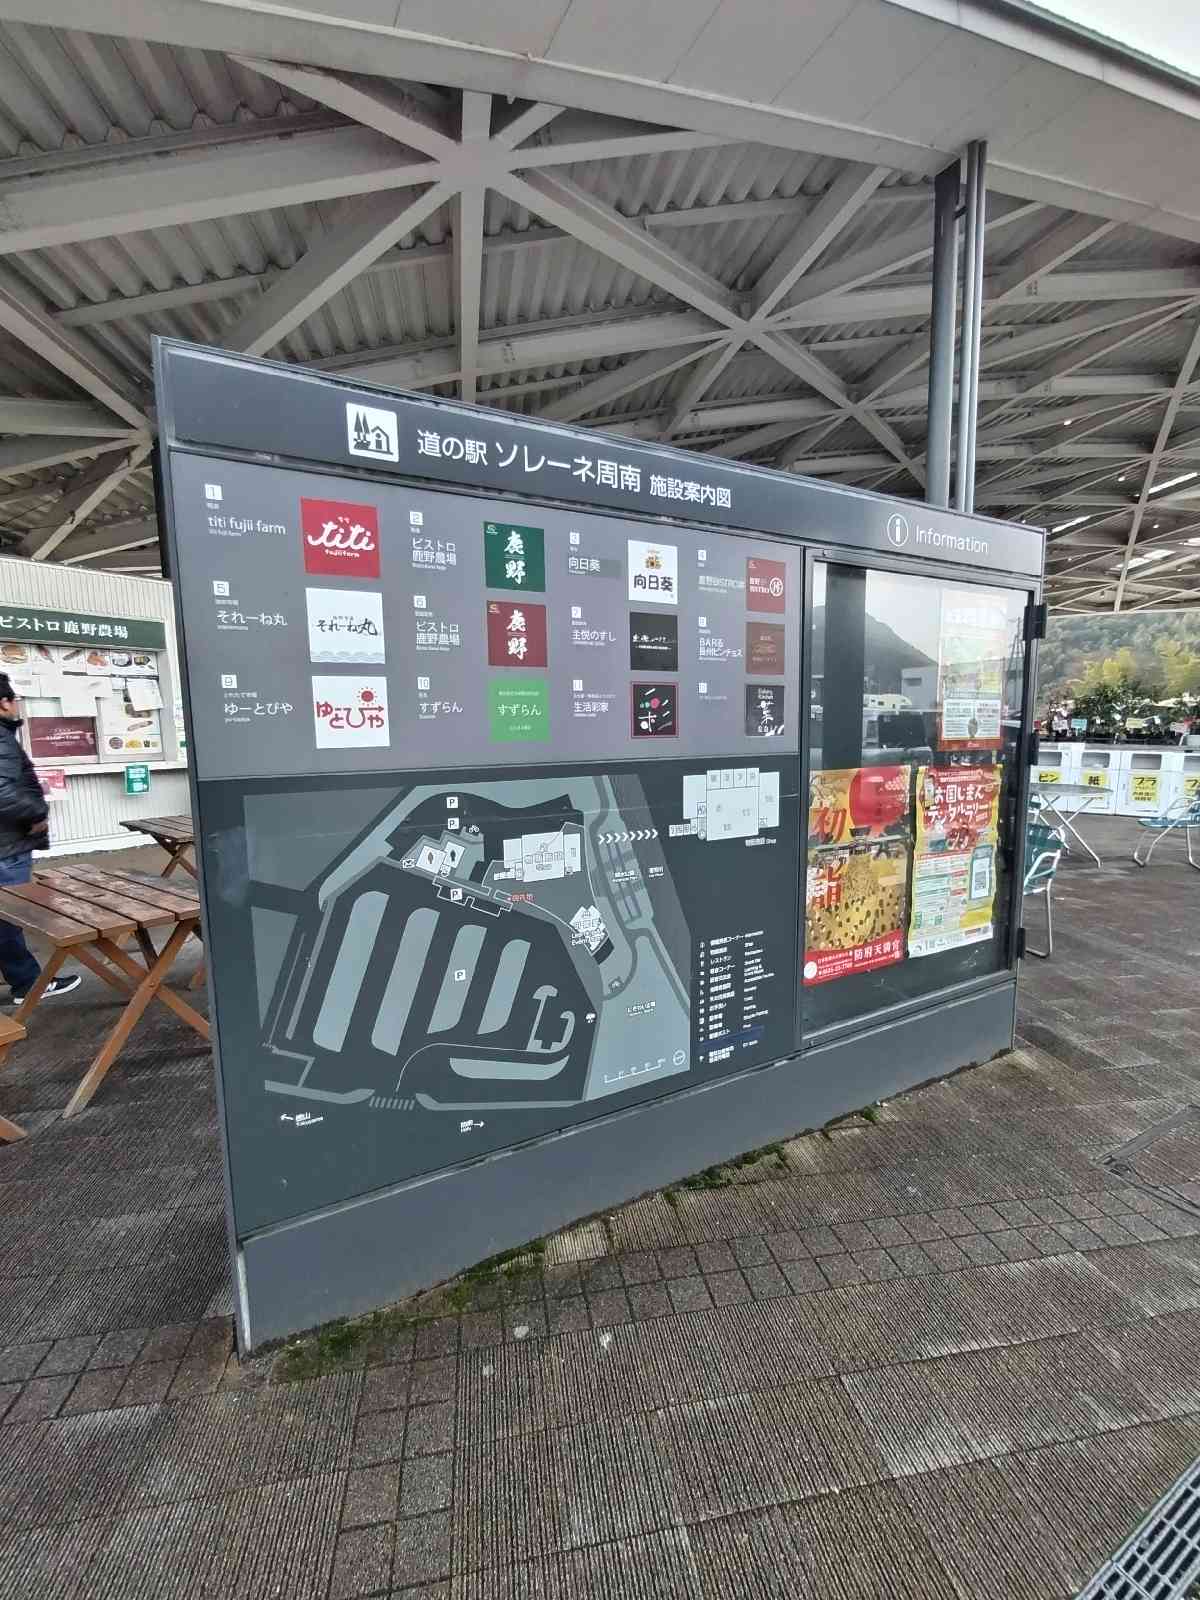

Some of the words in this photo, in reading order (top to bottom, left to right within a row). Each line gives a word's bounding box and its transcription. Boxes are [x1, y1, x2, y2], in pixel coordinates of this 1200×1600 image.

[417, 429, 488, 466] 道の駅
[496, 442, 641, 492] ソレーネ周南
[649, 474, 731, 508] 施設案内図
[208, 515, 226, 528] titi
[257, 520, 287, 535] farm
[307, 521, 375, 551] titi
[412, 537, 456, 552] ビストロ
[916, 525, 988, 553] Information
[568, 557, 601, 572] 向日葵
[633, 574, 673, 592] 向日葵
[0, 615, 60, 632] ビストロ
[63, 620, 129, 639] 鹿野農場
[216, 610, 289, 627] それーね丸
[316, 618, 379, 636] それーね丸
[416, 621, 459, 633] ビストロ
[224, 702, 294, 716] ゆーとぴや
[419, 702, 464, 714] すずらん
[497, 704, 542, 717] すずらん
[1132, 776, 1157, 787] プラ
